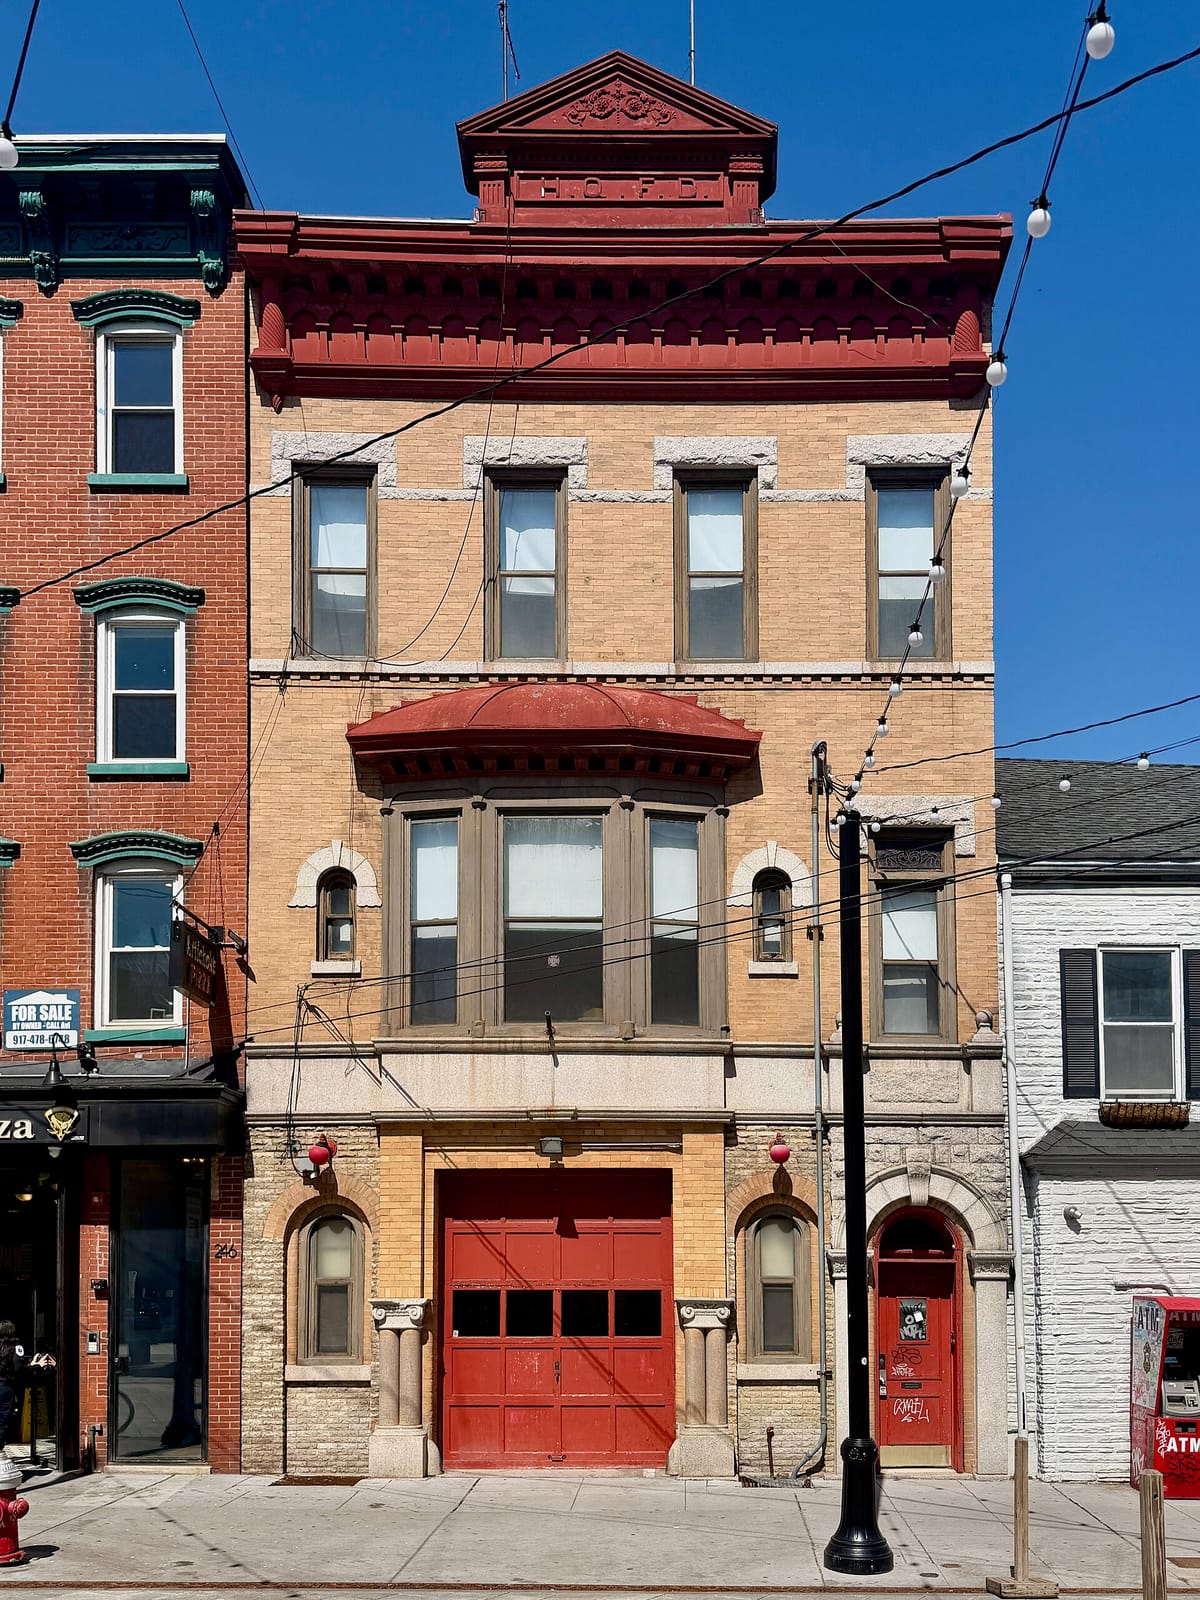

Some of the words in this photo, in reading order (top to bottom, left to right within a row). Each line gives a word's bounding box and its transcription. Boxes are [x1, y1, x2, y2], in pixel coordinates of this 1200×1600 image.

[11, 1005, 37, 1021] FOR
[39, 1005, 72, 1021] SALE
[20, 1022, 41, 1030] OWNER
[46, 1021, 60, 1029] CALL
[214, 1243, 238, 1259] 246
[1137, 1306, 1159, 1331] ATM
[1167, 1437, 1200, 1453] ATM
